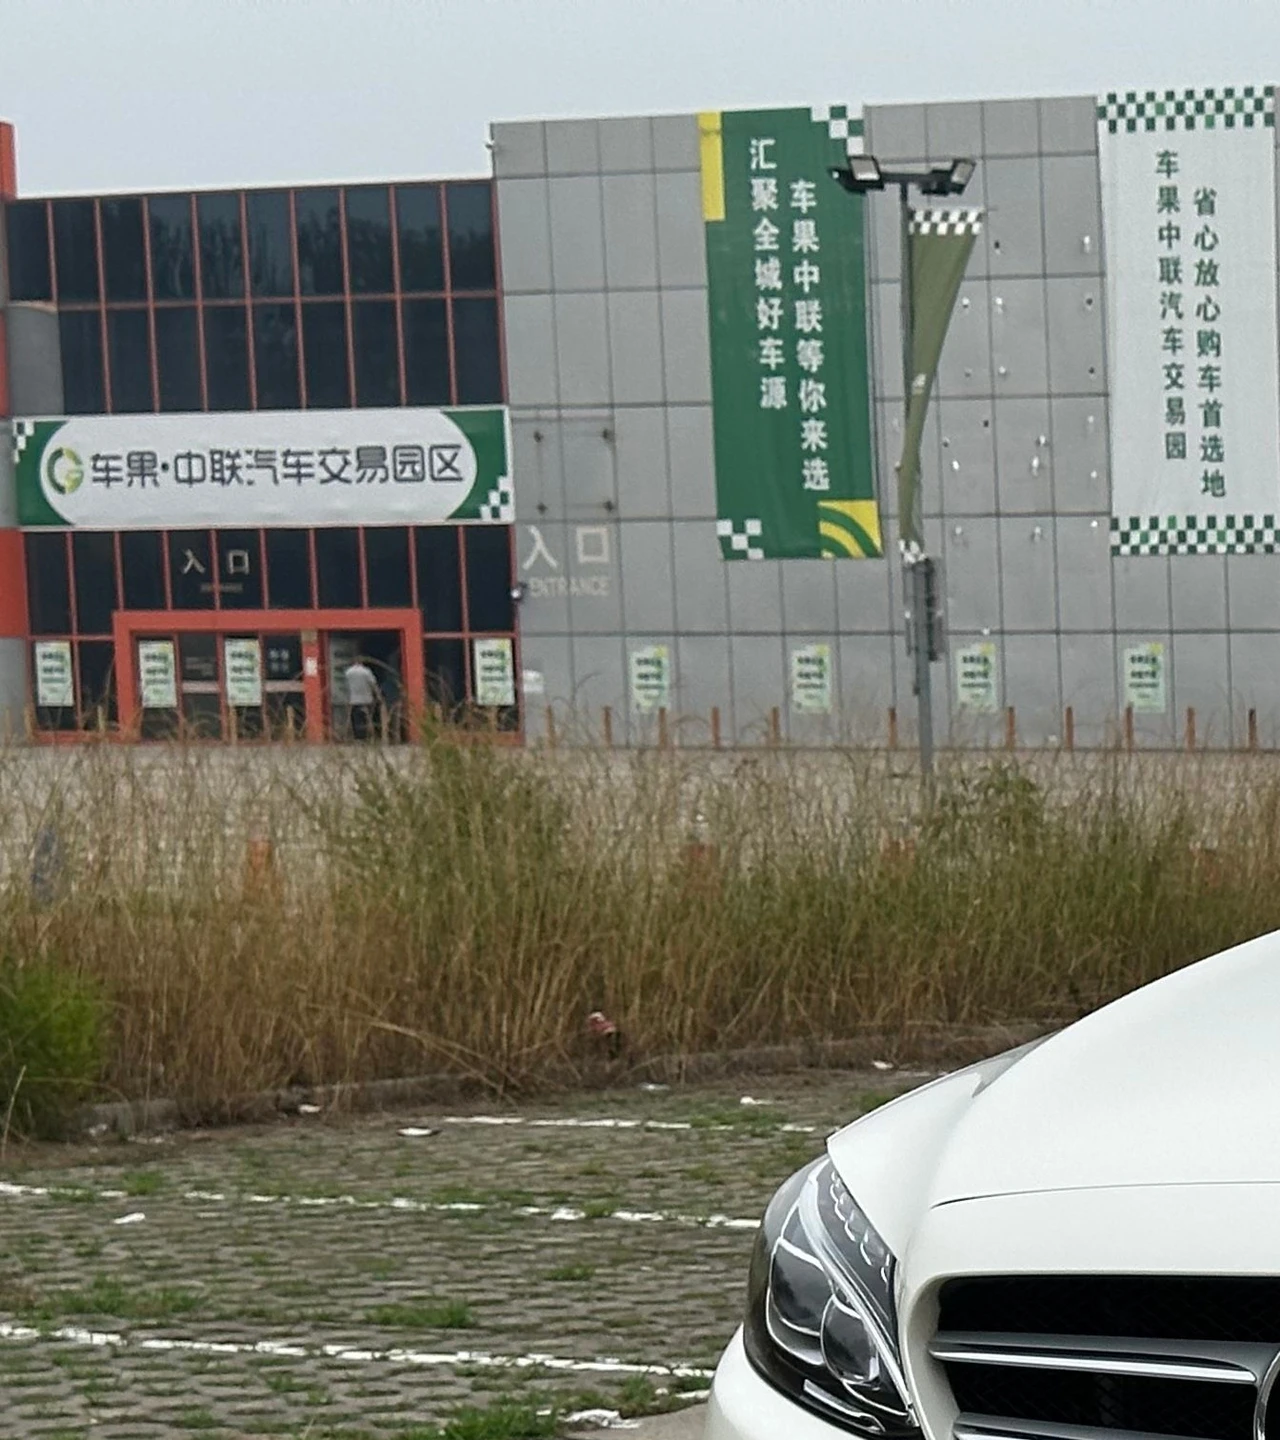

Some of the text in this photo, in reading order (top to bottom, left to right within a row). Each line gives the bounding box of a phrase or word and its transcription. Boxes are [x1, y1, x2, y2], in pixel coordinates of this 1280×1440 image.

[750, 138, 787, 410] 汇聚全城好车源
[790, 178, 830, 492] 车果中联等你来选
[1155, 149, 1187, 460] 车果中联汽车交易园
[1193, 186, 1226, 500] 省心放心购车首选地
[91, 443, 464, 488] 车果·中联汽车交易园区
[182, 548, 251, 576] 入口
[522, 524, 610, 571] 入口
